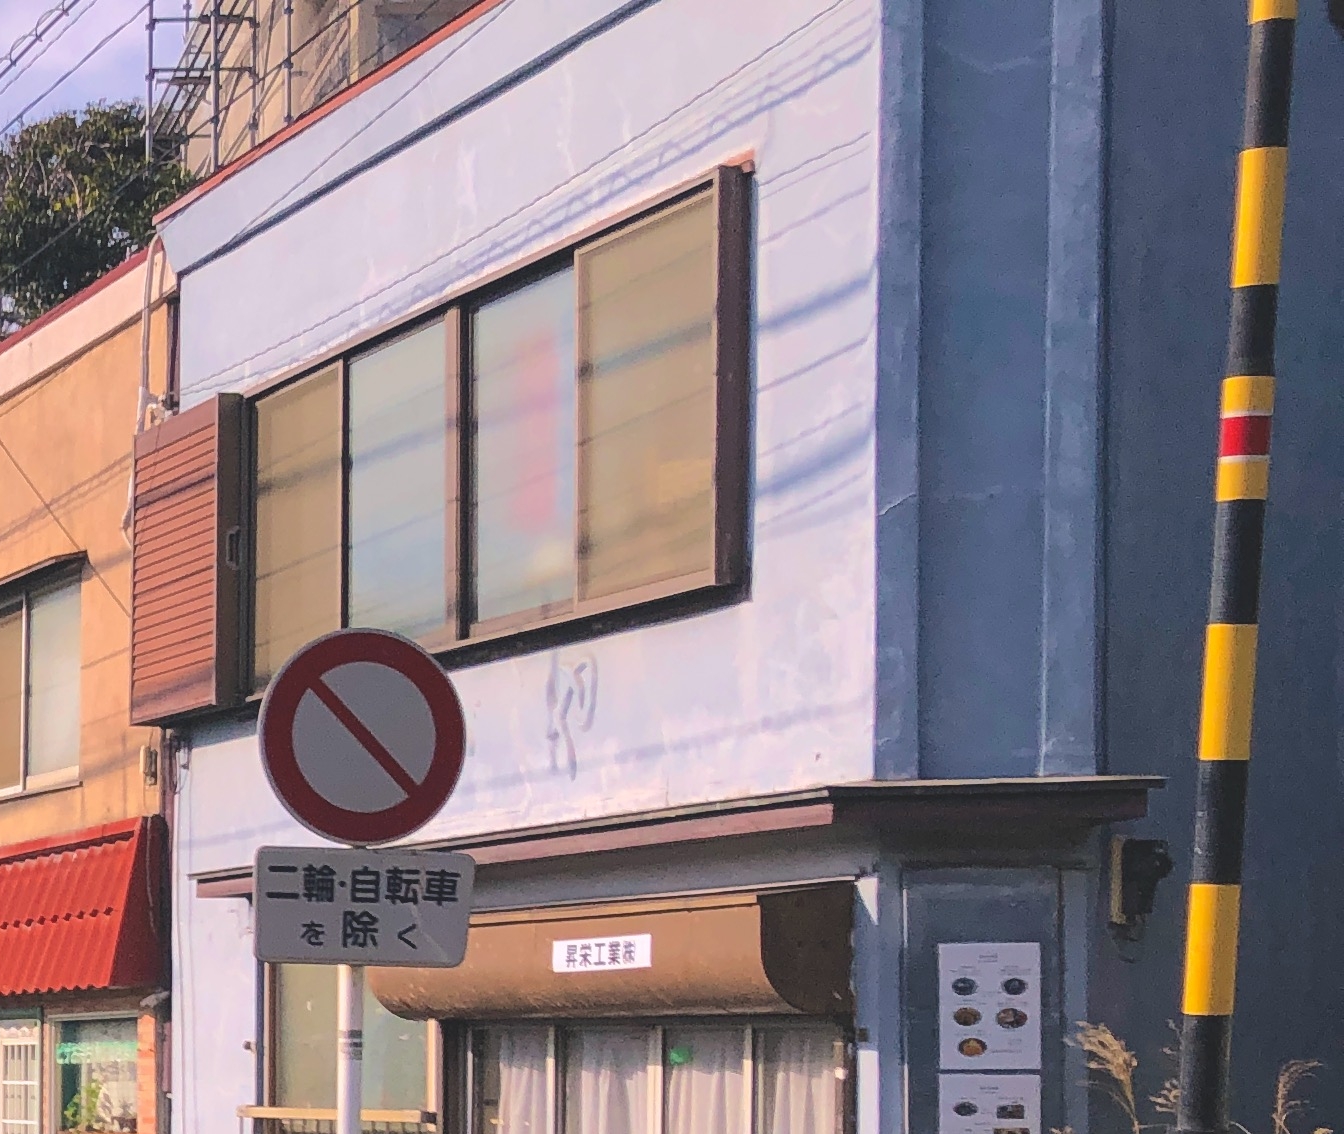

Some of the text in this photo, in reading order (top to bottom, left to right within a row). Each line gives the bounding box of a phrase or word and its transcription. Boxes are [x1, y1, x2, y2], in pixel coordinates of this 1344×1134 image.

[265, 863, 461, 906] 二輪・自転車
[299, 910, 418, 950] を除く
